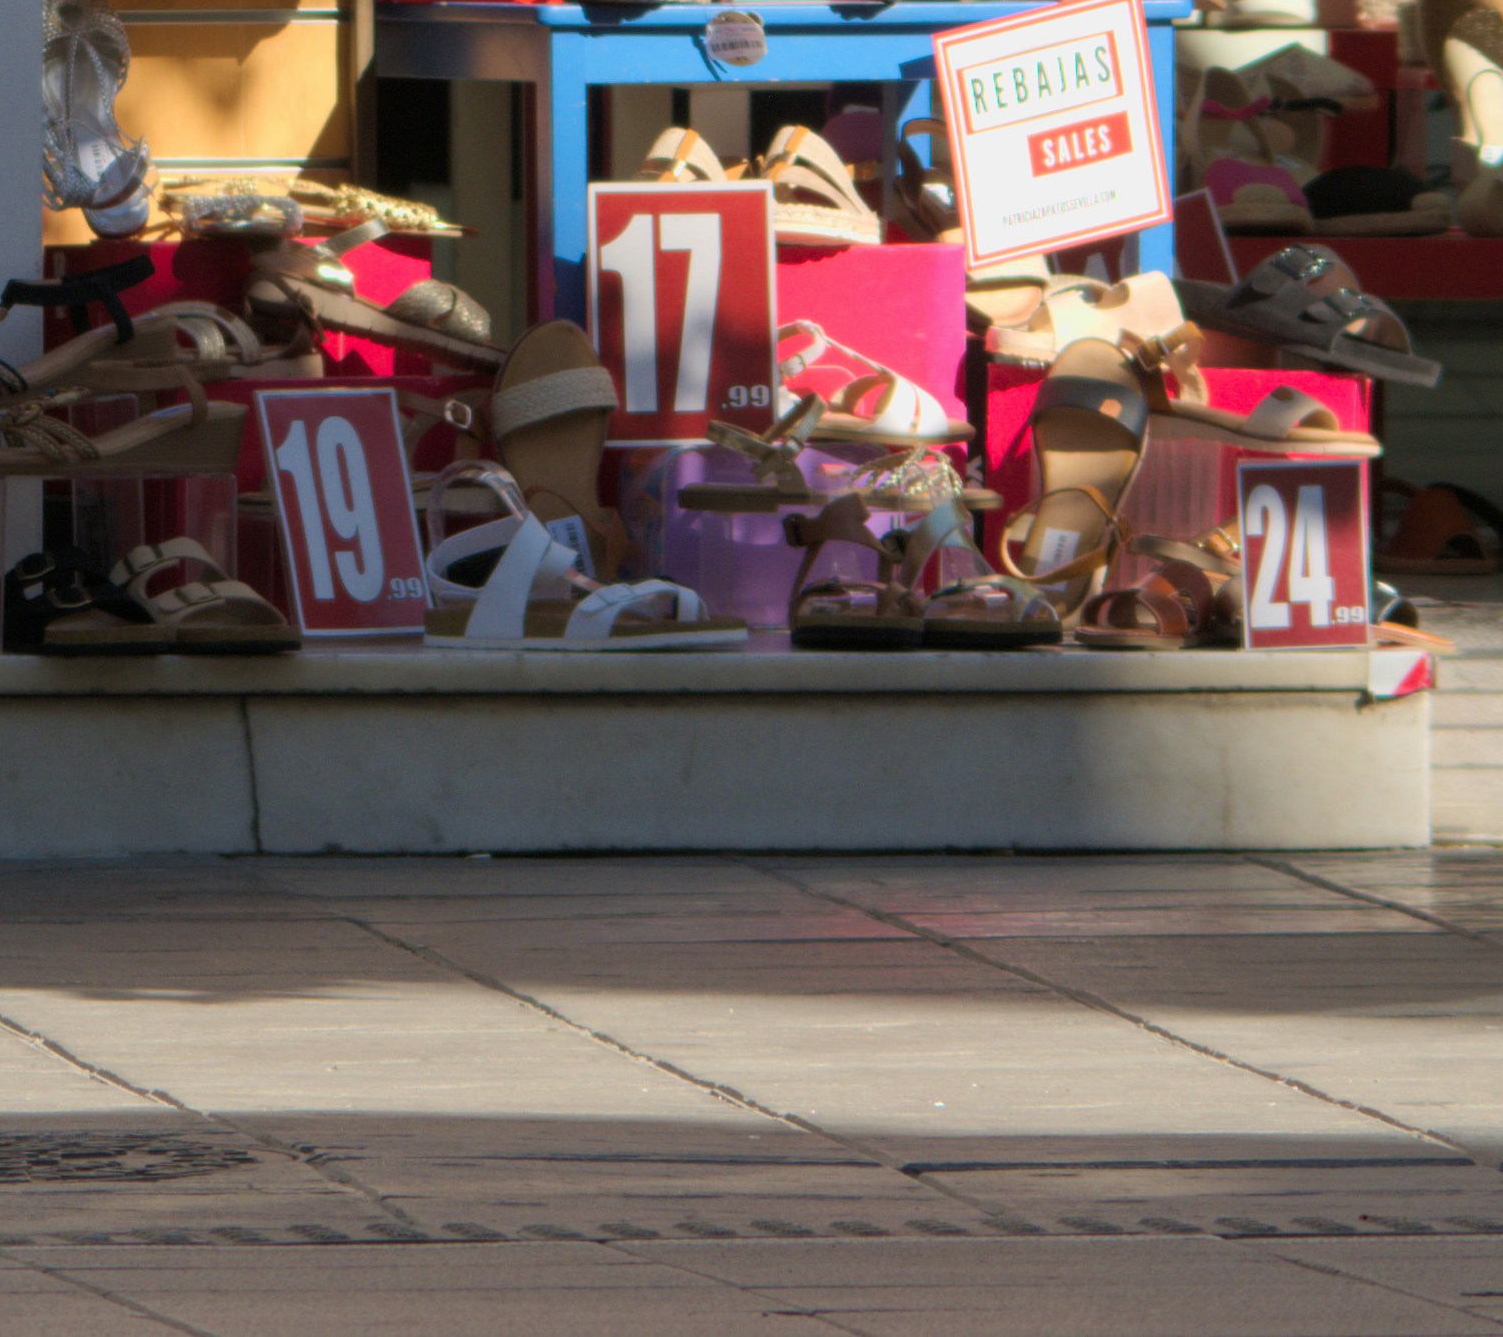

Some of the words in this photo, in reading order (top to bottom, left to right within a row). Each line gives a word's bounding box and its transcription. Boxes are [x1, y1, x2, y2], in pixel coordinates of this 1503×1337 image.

[971, 45, 1112, 115] REBAJAS
[1042, 124, 1113, 168] SALES
[1002, 188, 1116, 227] PATRICIAZAPATOSSEVILLA.COM
